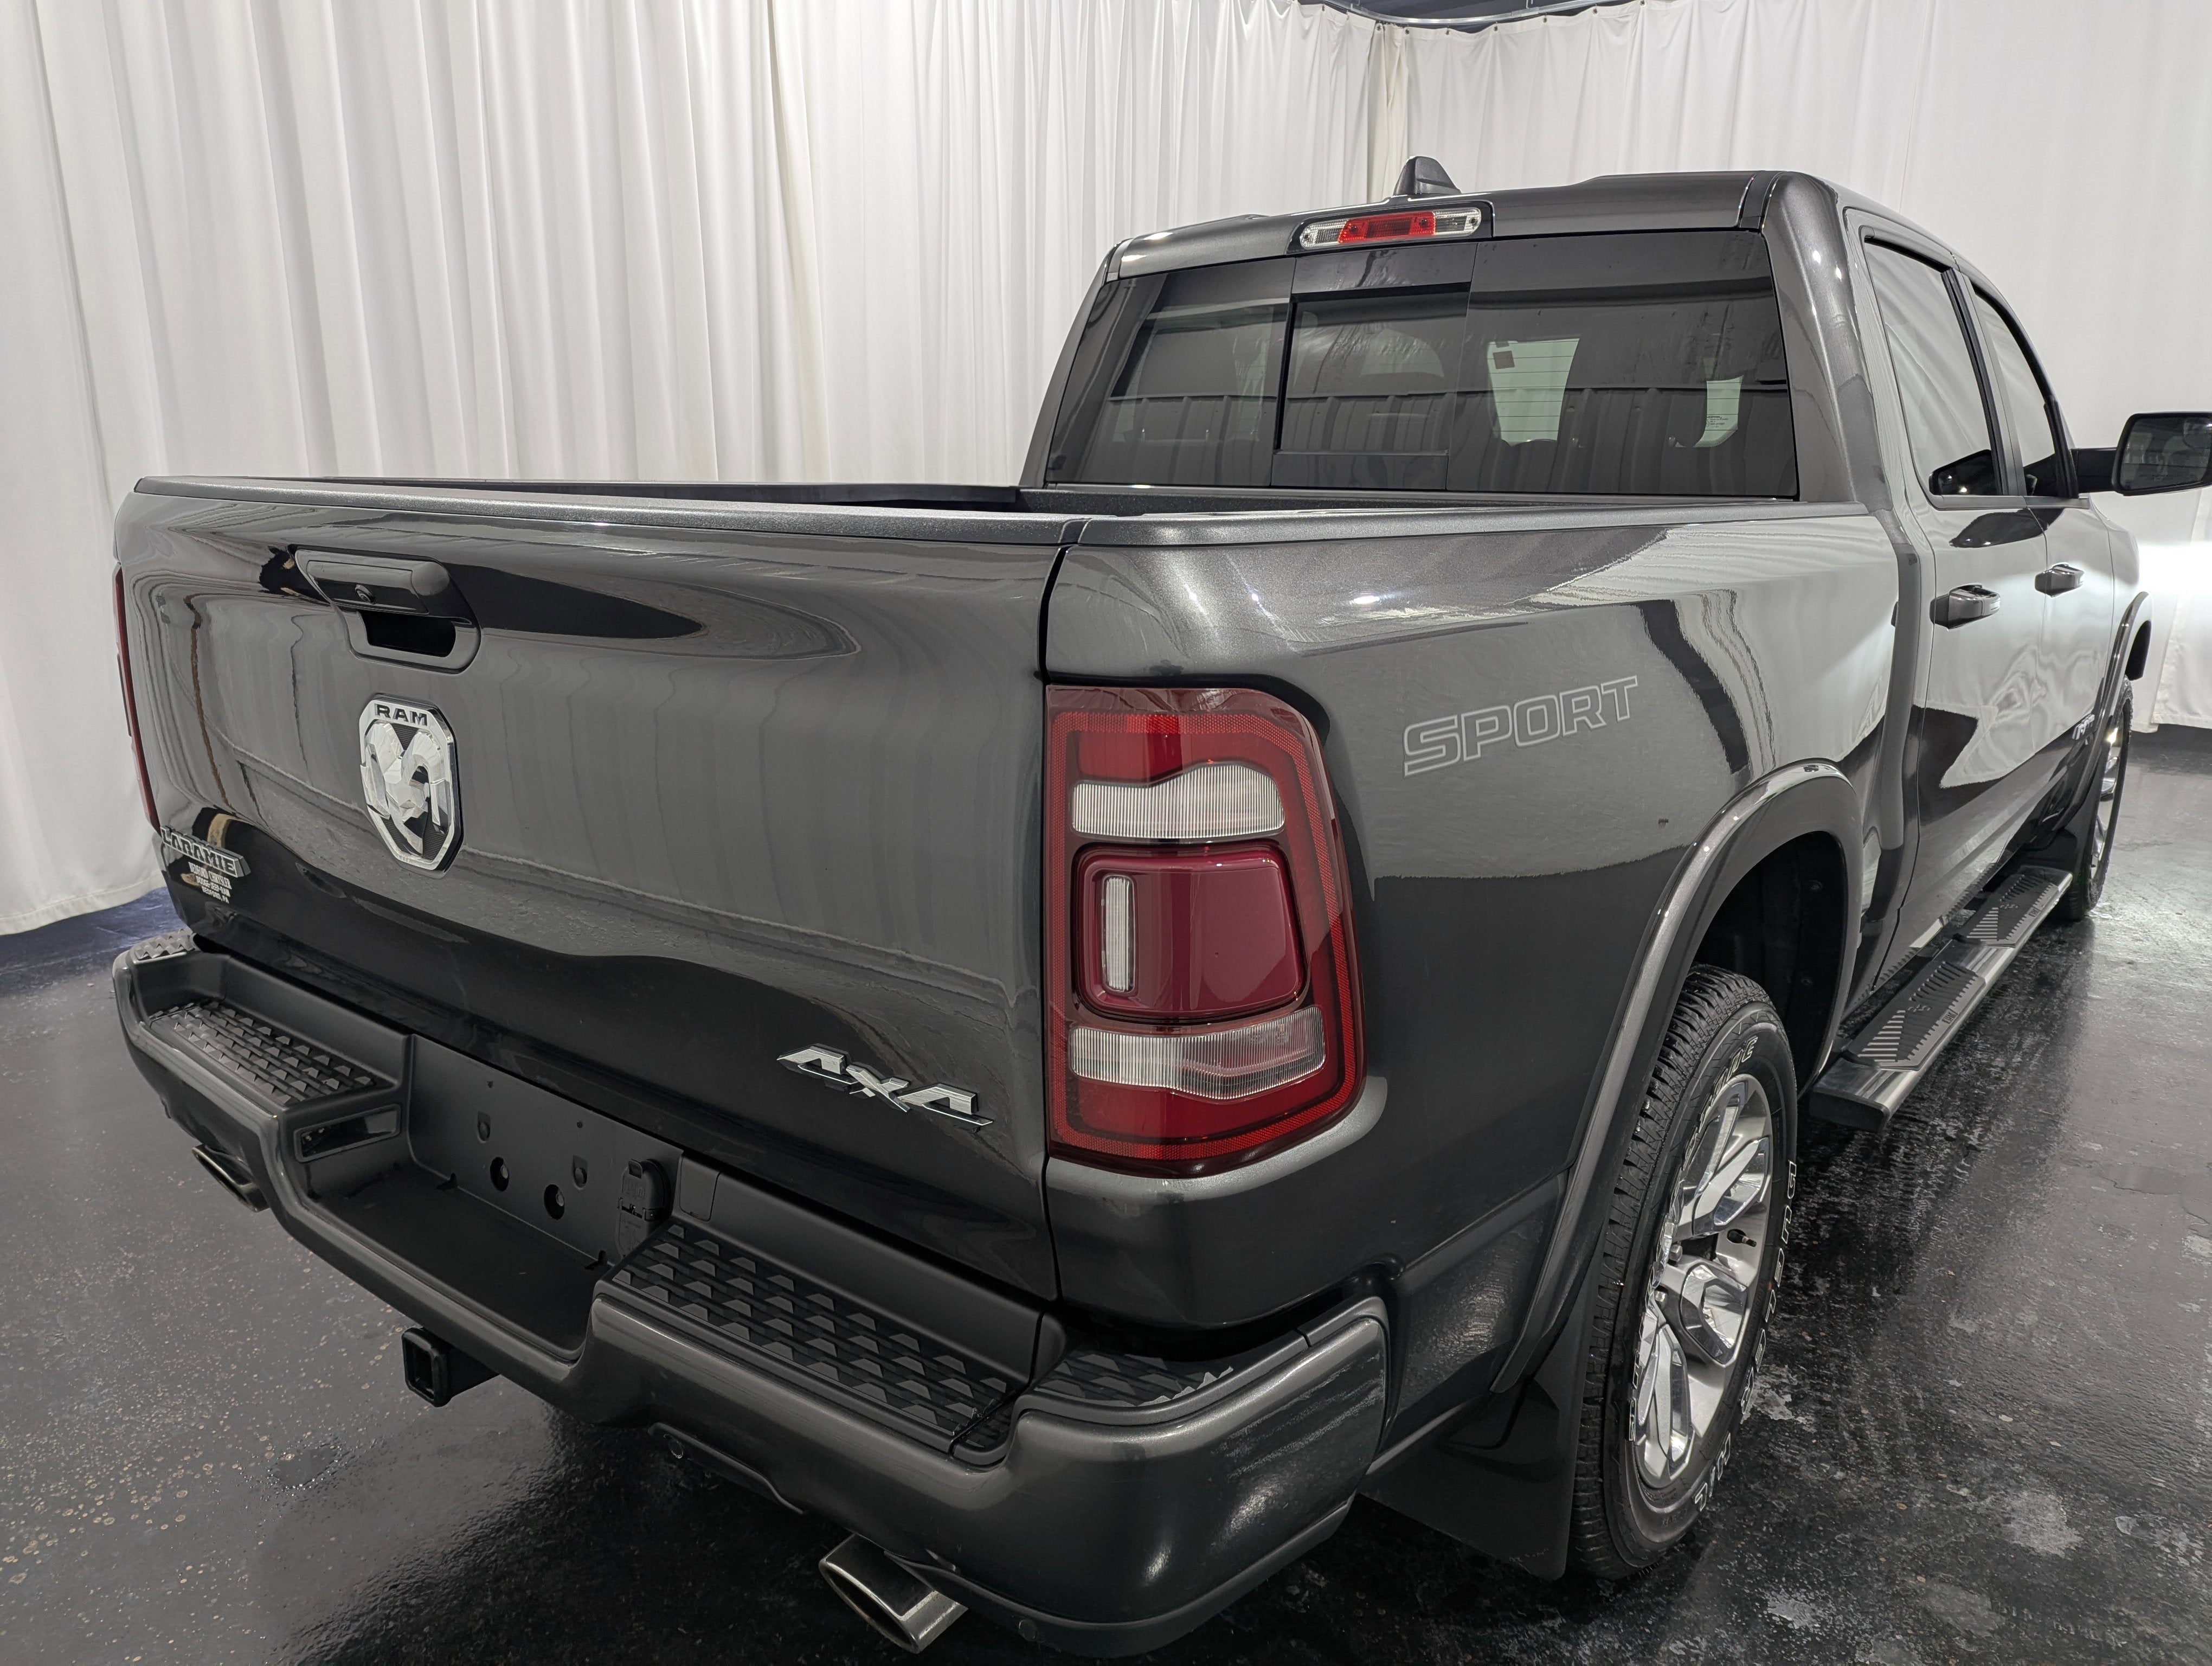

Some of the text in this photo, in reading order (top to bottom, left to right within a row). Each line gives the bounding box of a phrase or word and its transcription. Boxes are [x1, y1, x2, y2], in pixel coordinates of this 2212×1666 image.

[374, 703, 427, 726] RAM
[1404, 675, 1638, 777] SPORT
[160, 826, 238, 877] LARAMIE
